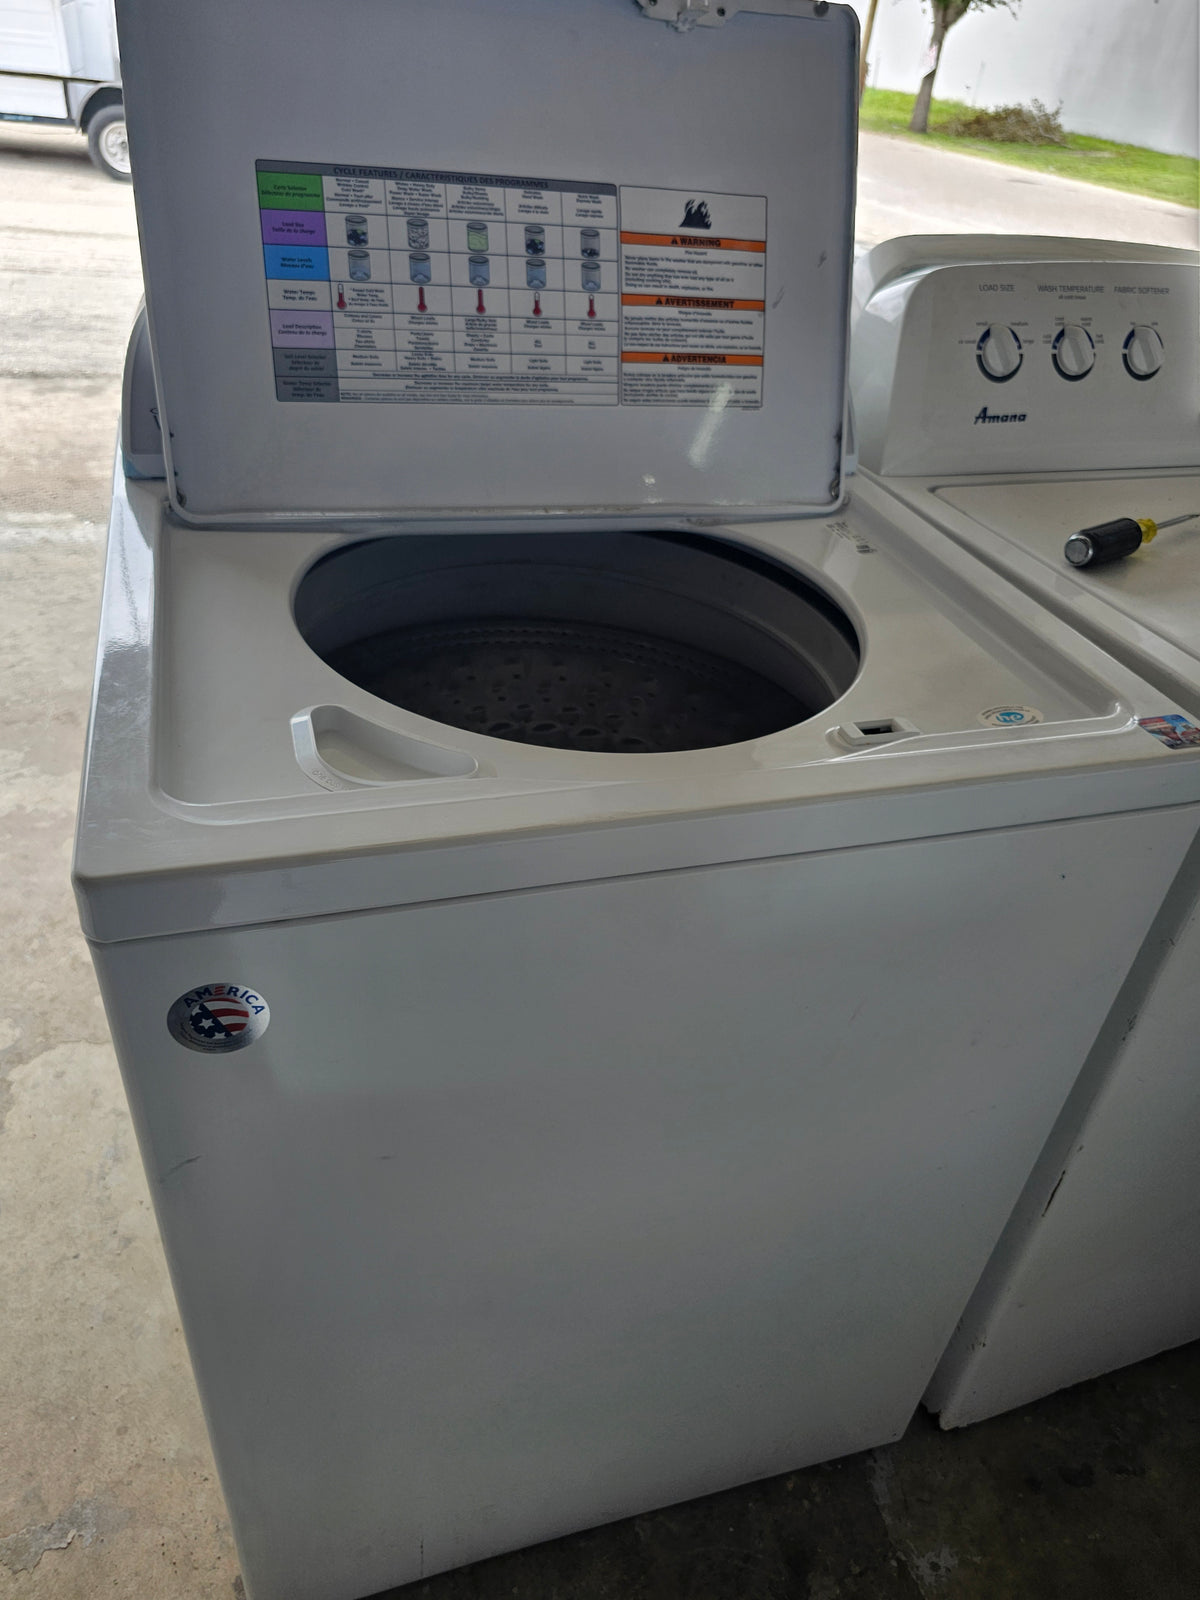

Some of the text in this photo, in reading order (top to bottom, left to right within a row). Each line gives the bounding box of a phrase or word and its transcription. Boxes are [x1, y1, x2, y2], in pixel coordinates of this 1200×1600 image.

[680, 238, 721, 248] WARNING
[979, 284, 999, 292] LOAD
[1037, 285, 1104, 294] WASH TEMPERATURE
[1114, 286, 1170, 295] FABRIC SOFTENER
[665, 298, 735, 308] AVERTISSEMENT
[671, 356, 727, 364] ADVERTENCIA
[973, 406, 1027, 425] Amana
[183, 986, 266, 1015] AMERICA
